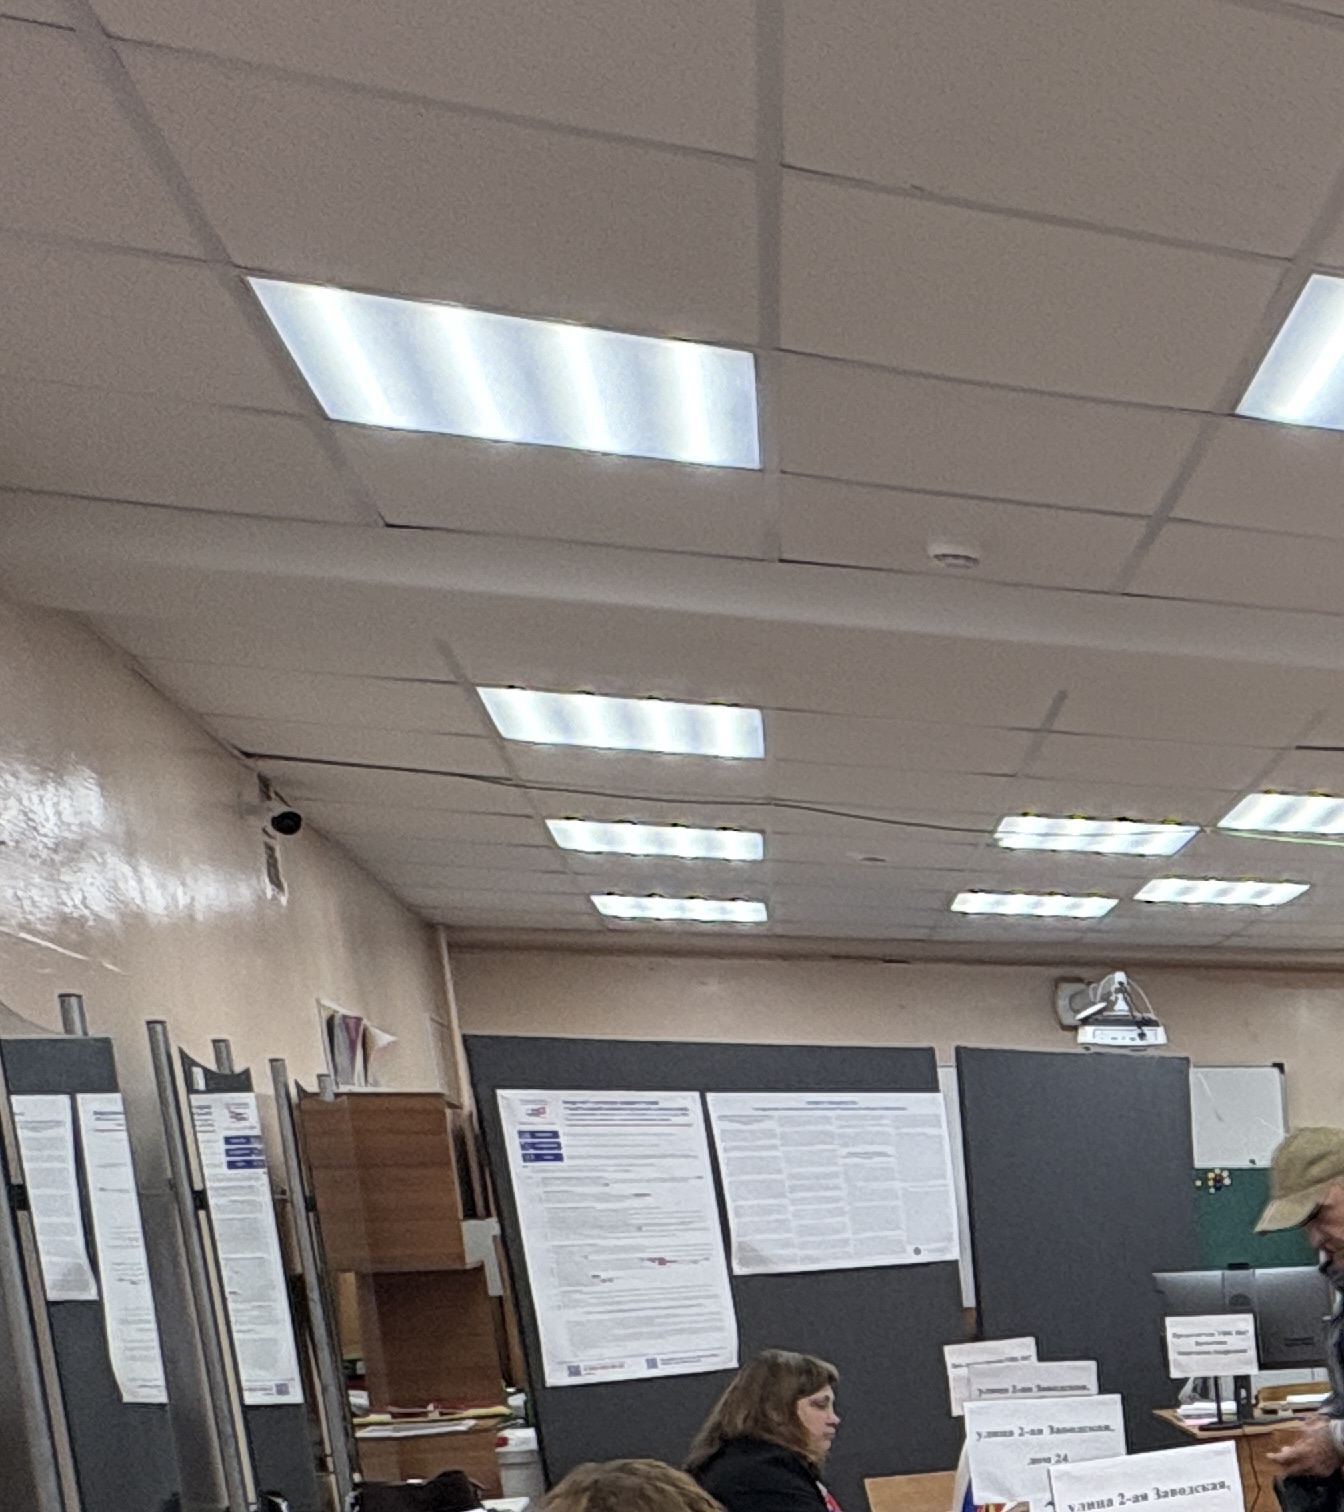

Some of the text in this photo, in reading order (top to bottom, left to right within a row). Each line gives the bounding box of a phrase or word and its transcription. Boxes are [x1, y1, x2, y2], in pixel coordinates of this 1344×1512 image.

[1055, 1453, 1070, 1464] 24
[1117, 1492, 1149, 1507] 2-ая
[1153, 1480, 1231, 1500] Заводская,
